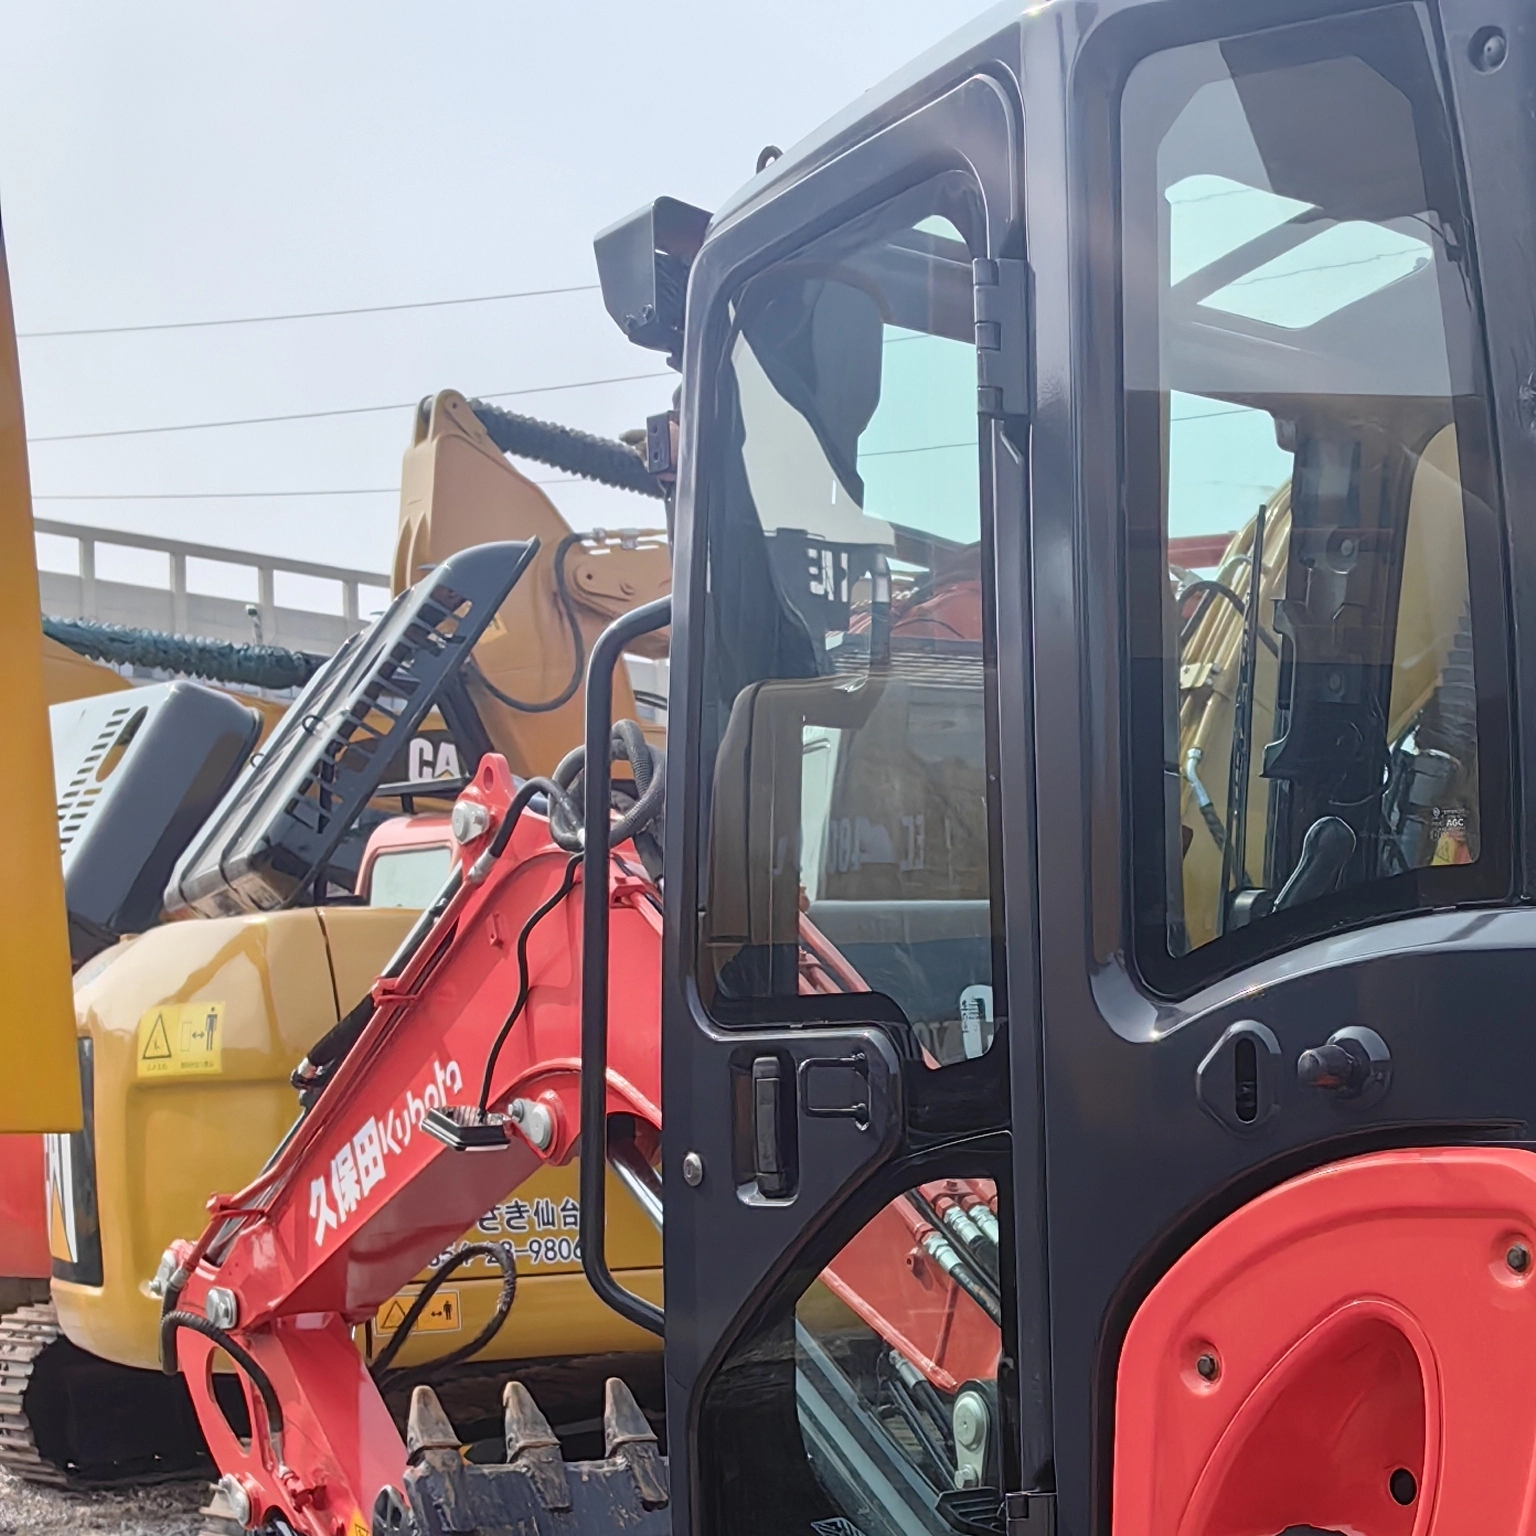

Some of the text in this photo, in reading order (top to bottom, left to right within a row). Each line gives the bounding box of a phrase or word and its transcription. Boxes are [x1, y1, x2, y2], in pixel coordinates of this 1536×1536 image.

[309, 1060, 463, 1247] 久保田 Kubota
